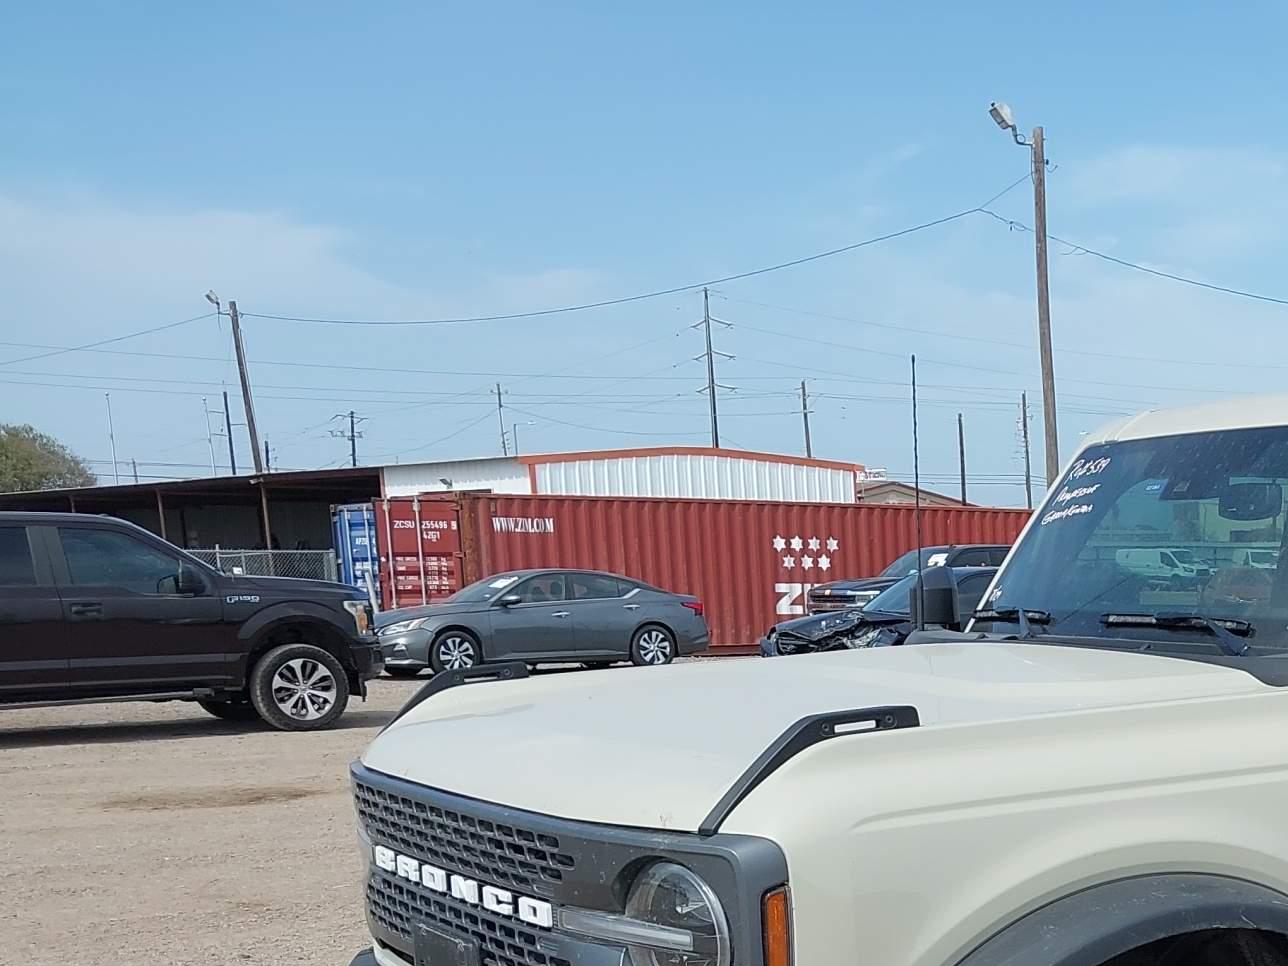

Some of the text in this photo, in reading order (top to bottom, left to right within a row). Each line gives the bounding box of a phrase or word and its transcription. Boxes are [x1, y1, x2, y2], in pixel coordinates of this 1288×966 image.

[393, 520, 415, 529] ZCSU
[421, 520, 448, 529] 255496
[423, 531, 441, 540] 42G1
[774, 583, 825, 615] ZI
[375, 845, 553, 928] BRONCO
